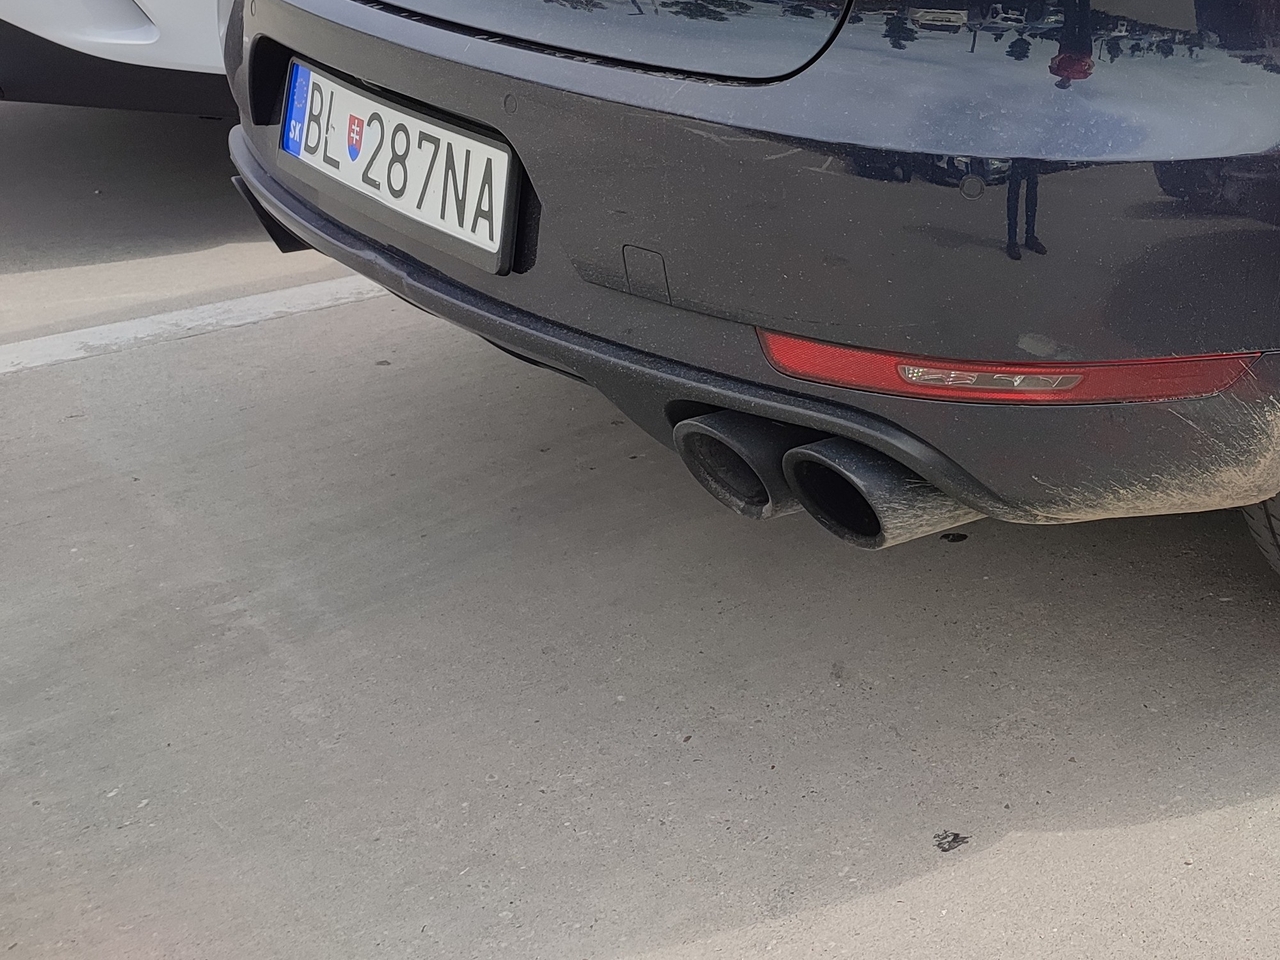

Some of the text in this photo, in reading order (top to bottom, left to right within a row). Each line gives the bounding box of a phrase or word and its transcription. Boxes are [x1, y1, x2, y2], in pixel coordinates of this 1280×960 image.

[289, 119, 302, 143] SK
[303, 81, 496, 242] BL 287NA
